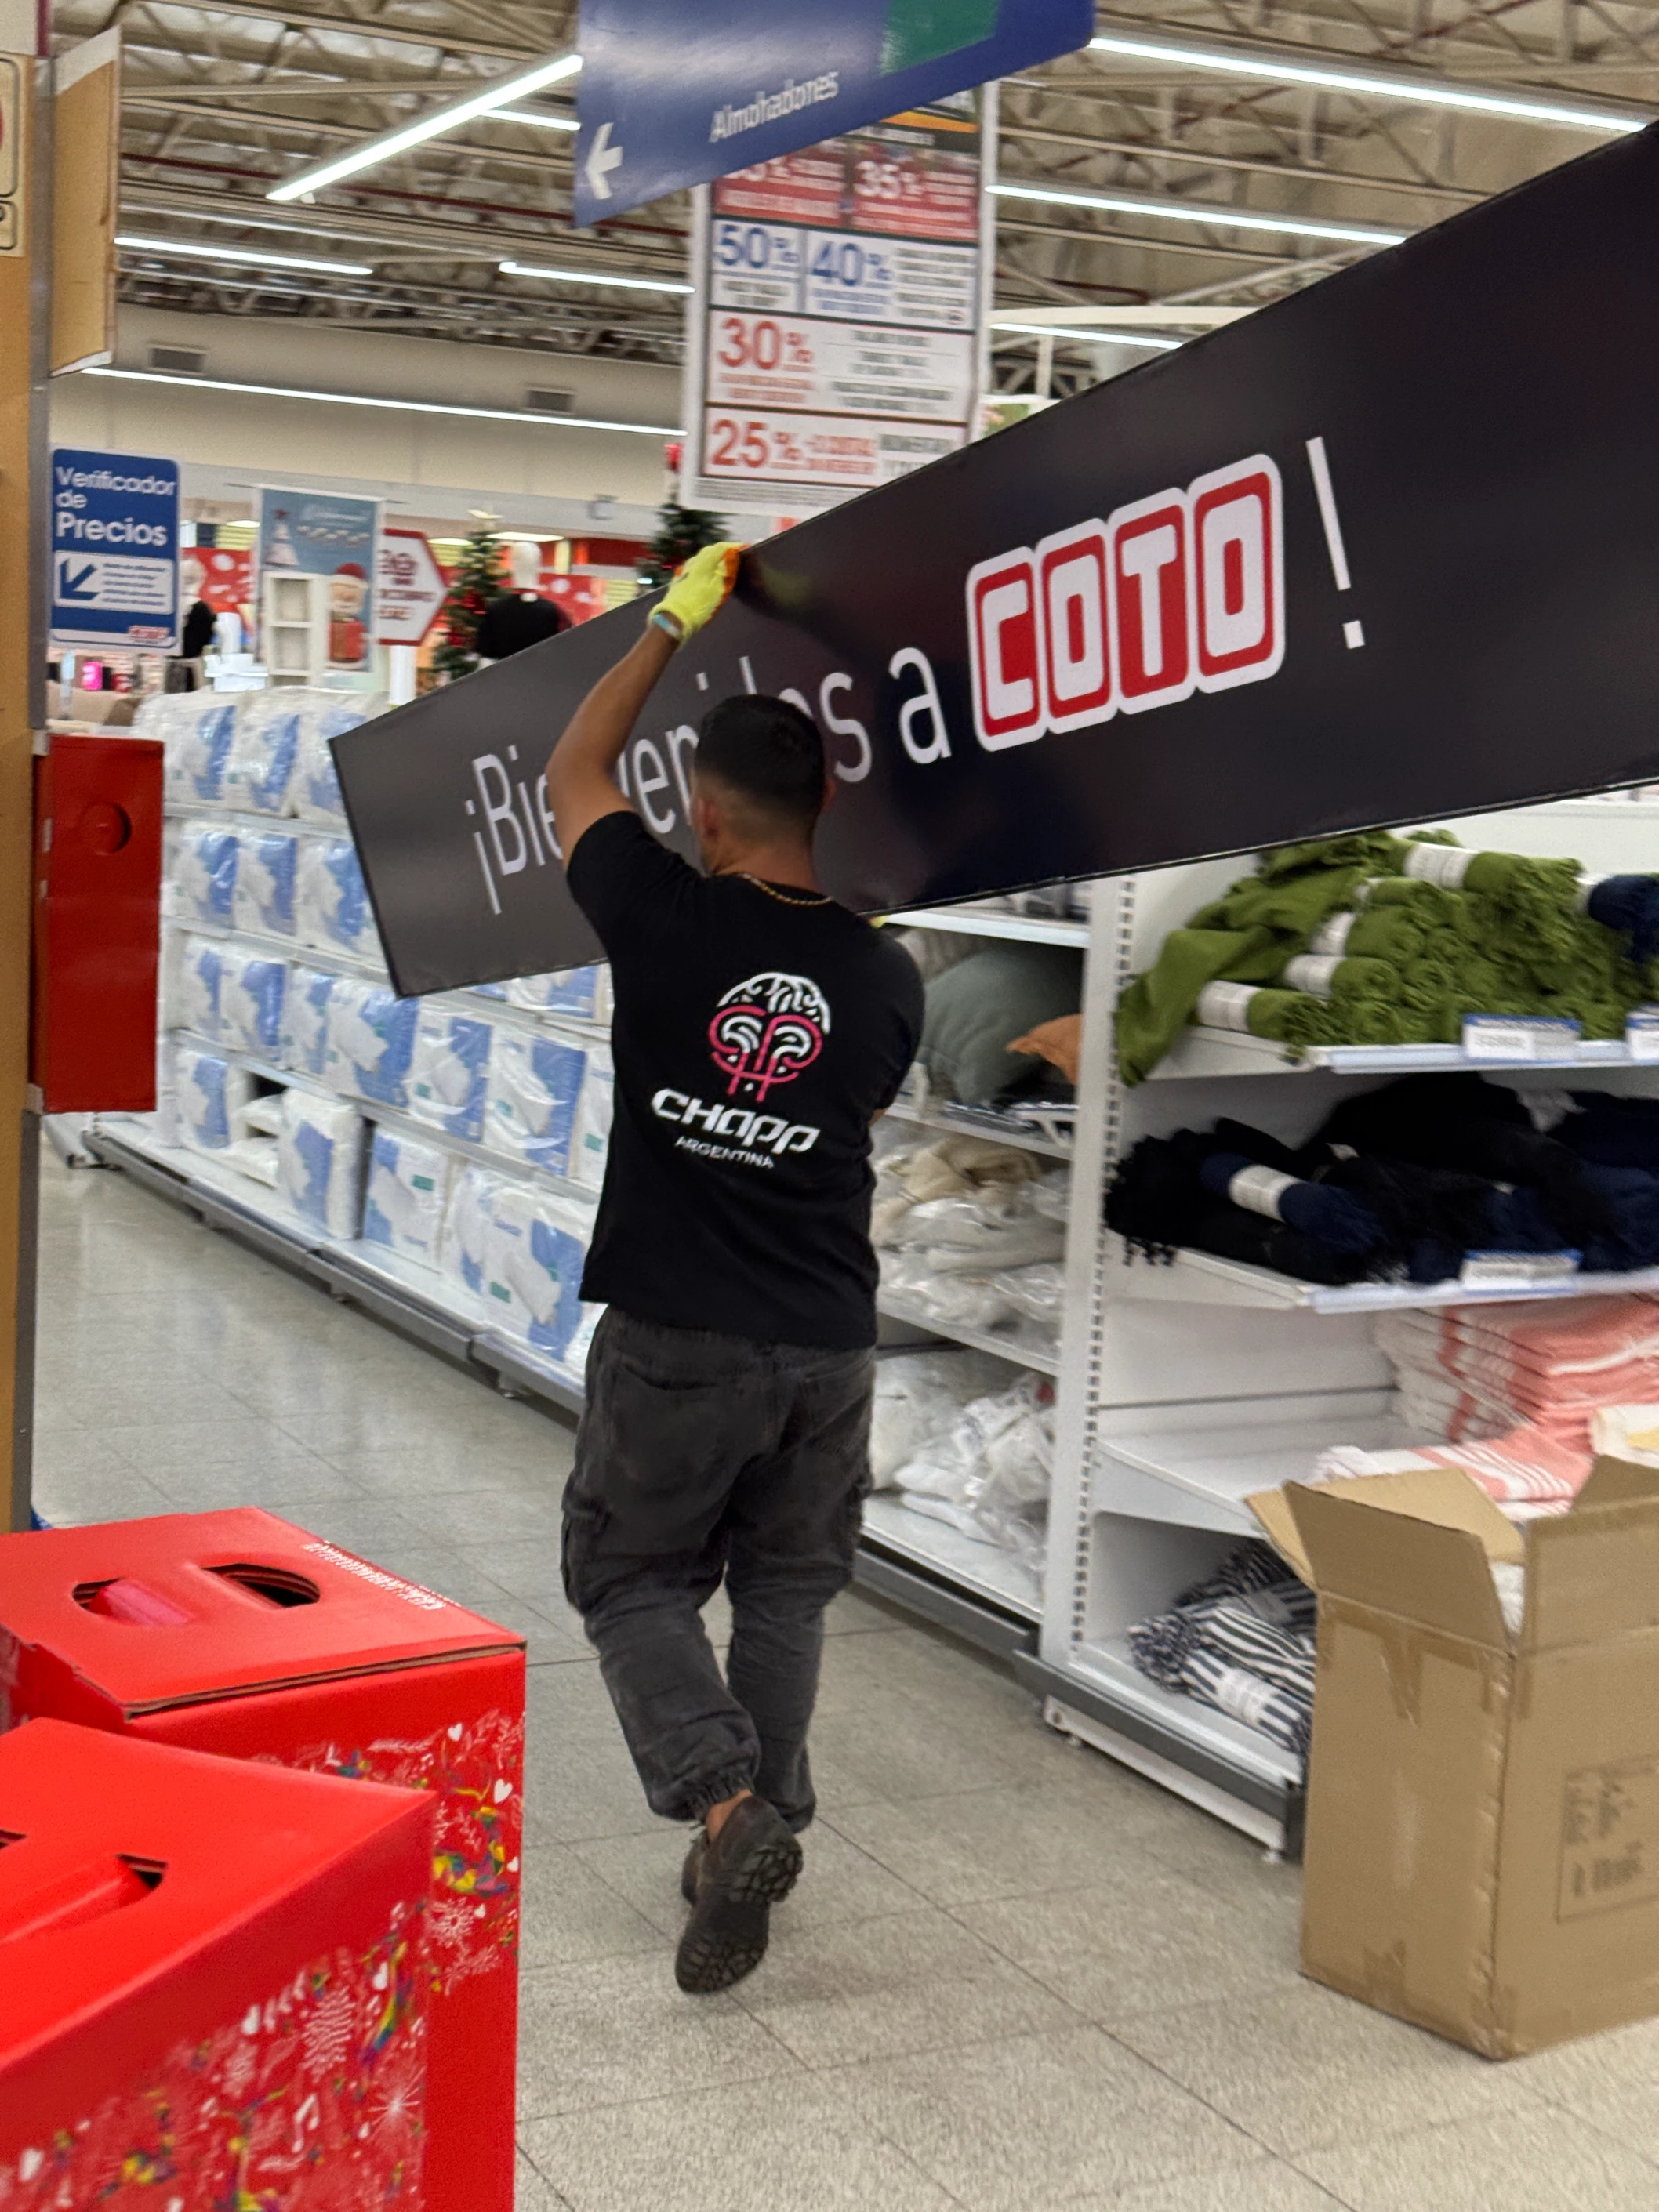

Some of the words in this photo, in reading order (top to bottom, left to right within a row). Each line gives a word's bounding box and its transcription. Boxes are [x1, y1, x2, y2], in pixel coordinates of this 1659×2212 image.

[708, 71, 839, 143] Almohadones
[718, 317, 815, 371] 30%
[711, 419, 803, 468] 25%
[55, 466, 176, 496] Verificador
[55, 488, 88, 509] de
[56, 511, 168, 546] Precios
[888, 647, 952, 764] a
[674, 1136, 775, 1169] ARGENTINA
